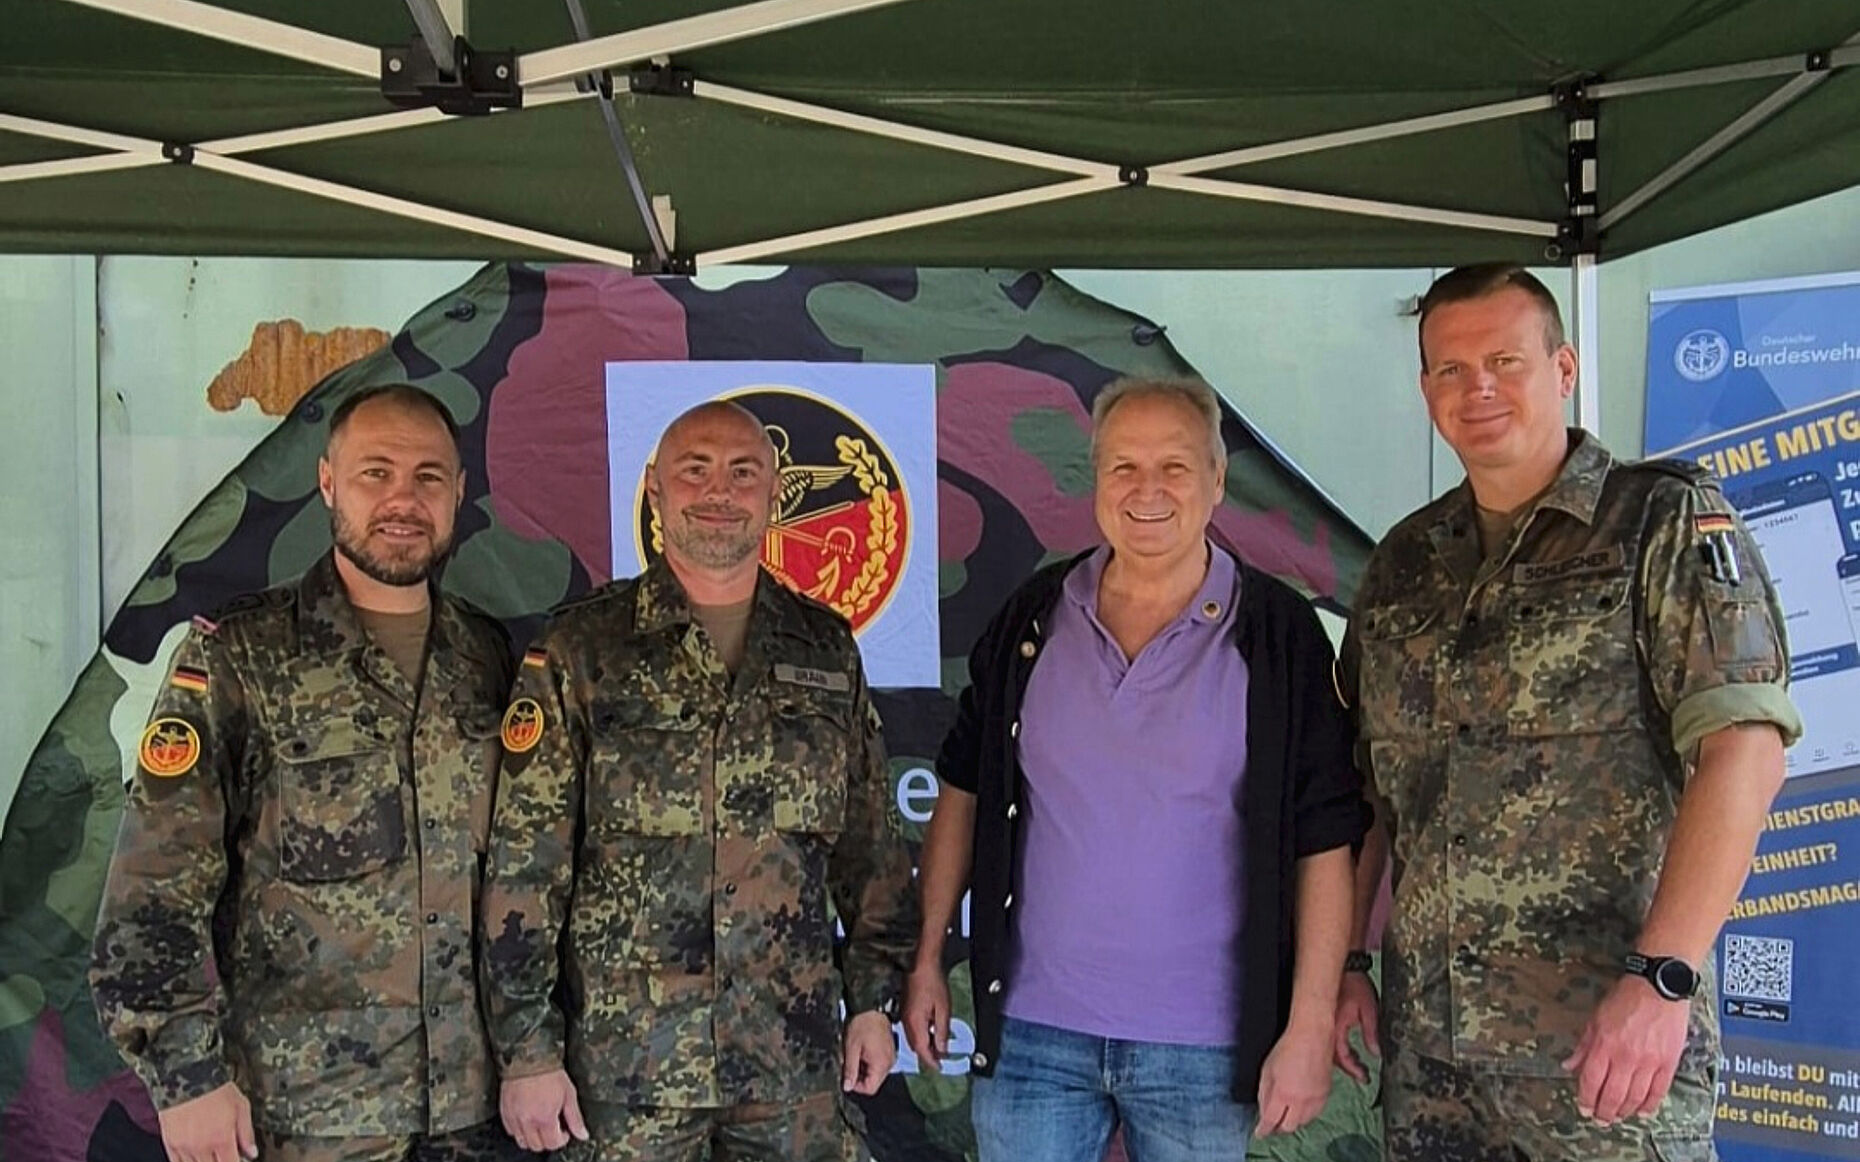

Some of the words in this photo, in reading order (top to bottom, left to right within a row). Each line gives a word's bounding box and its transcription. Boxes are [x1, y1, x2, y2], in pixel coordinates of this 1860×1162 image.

[1764, 798, 1860, 831] IENSTGRA
[1752, 842, 1838, 874] EINHEIT?
[1728, 879, 1860, 920] RBANDSMAG
[1735, 1054, 1794, 1079] bleibst
[1797, 1063, 1825, 1083] DU
[1731, 1079, 1833, 1110] Laufenden.
[1752, 1107, 1819, 1133] einfach
[1823, 1120, 1859, 1139] und
